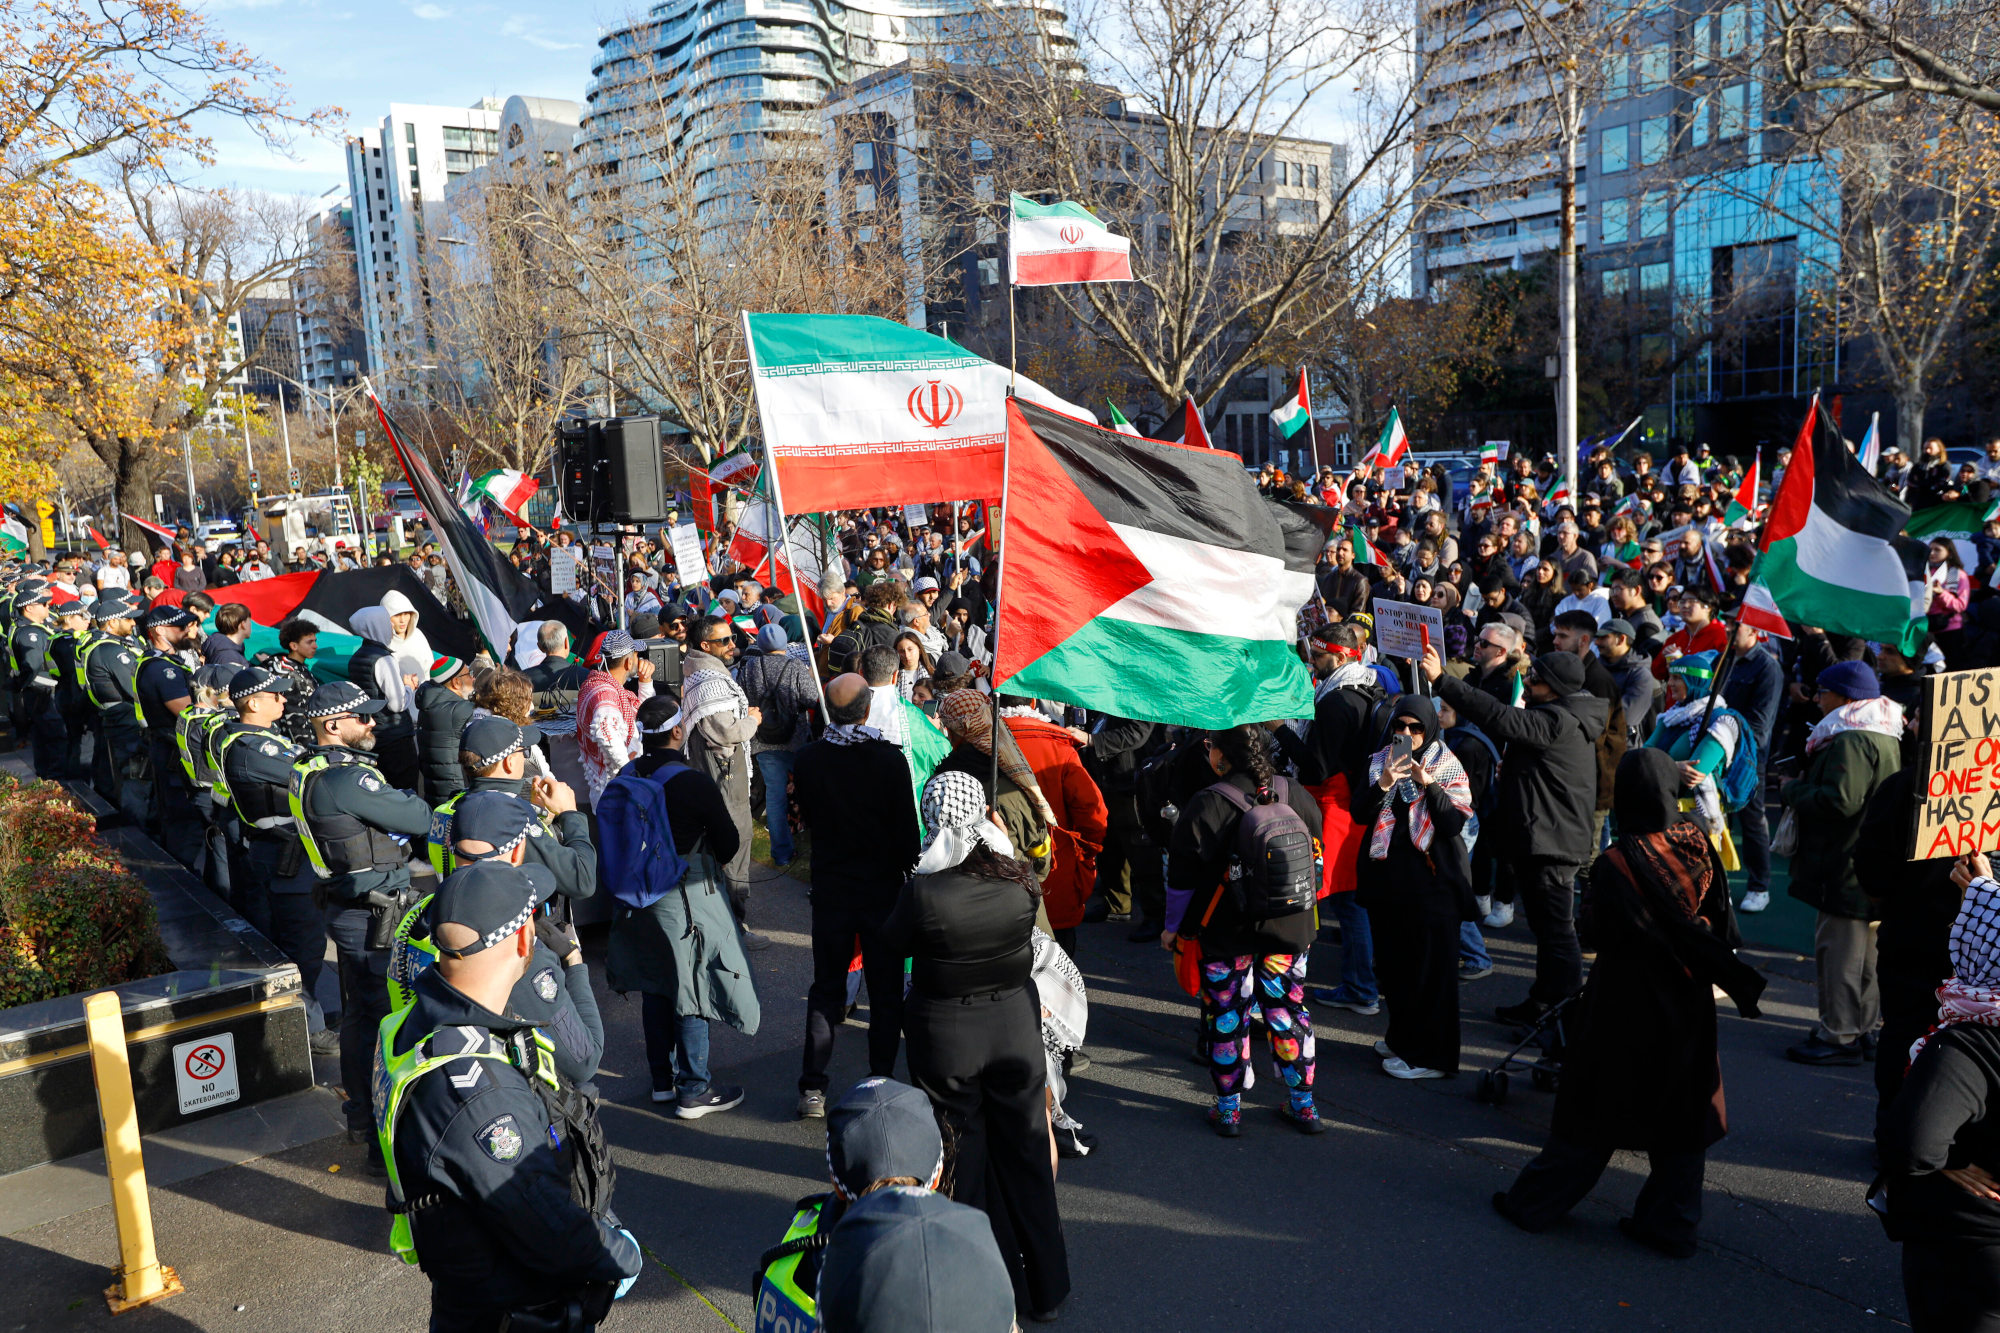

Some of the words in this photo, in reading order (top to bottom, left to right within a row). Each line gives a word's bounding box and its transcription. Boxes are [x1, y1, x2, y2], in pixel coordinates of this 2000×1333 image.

[1384, 608, 1402, 618] STOP
[1404, 611, 1419, 621] THE
[1419, 614, 1438, 625] WAR
[1393, 619, 1403, 628] ON
[1405, 621, 1421, 631] IRA
[1940, 672, 1993, 708] IT'S
[1940, 706, 1972, 741] A
[1936, 740, 1965, 772] IF
[1928, 766, 1984, 798] ONE
[1926, 795, 1974, 827] HAS
[183, 1089, 236, 1108] SKATEBOARDING
[202, 1082, 215, 1093] NO
